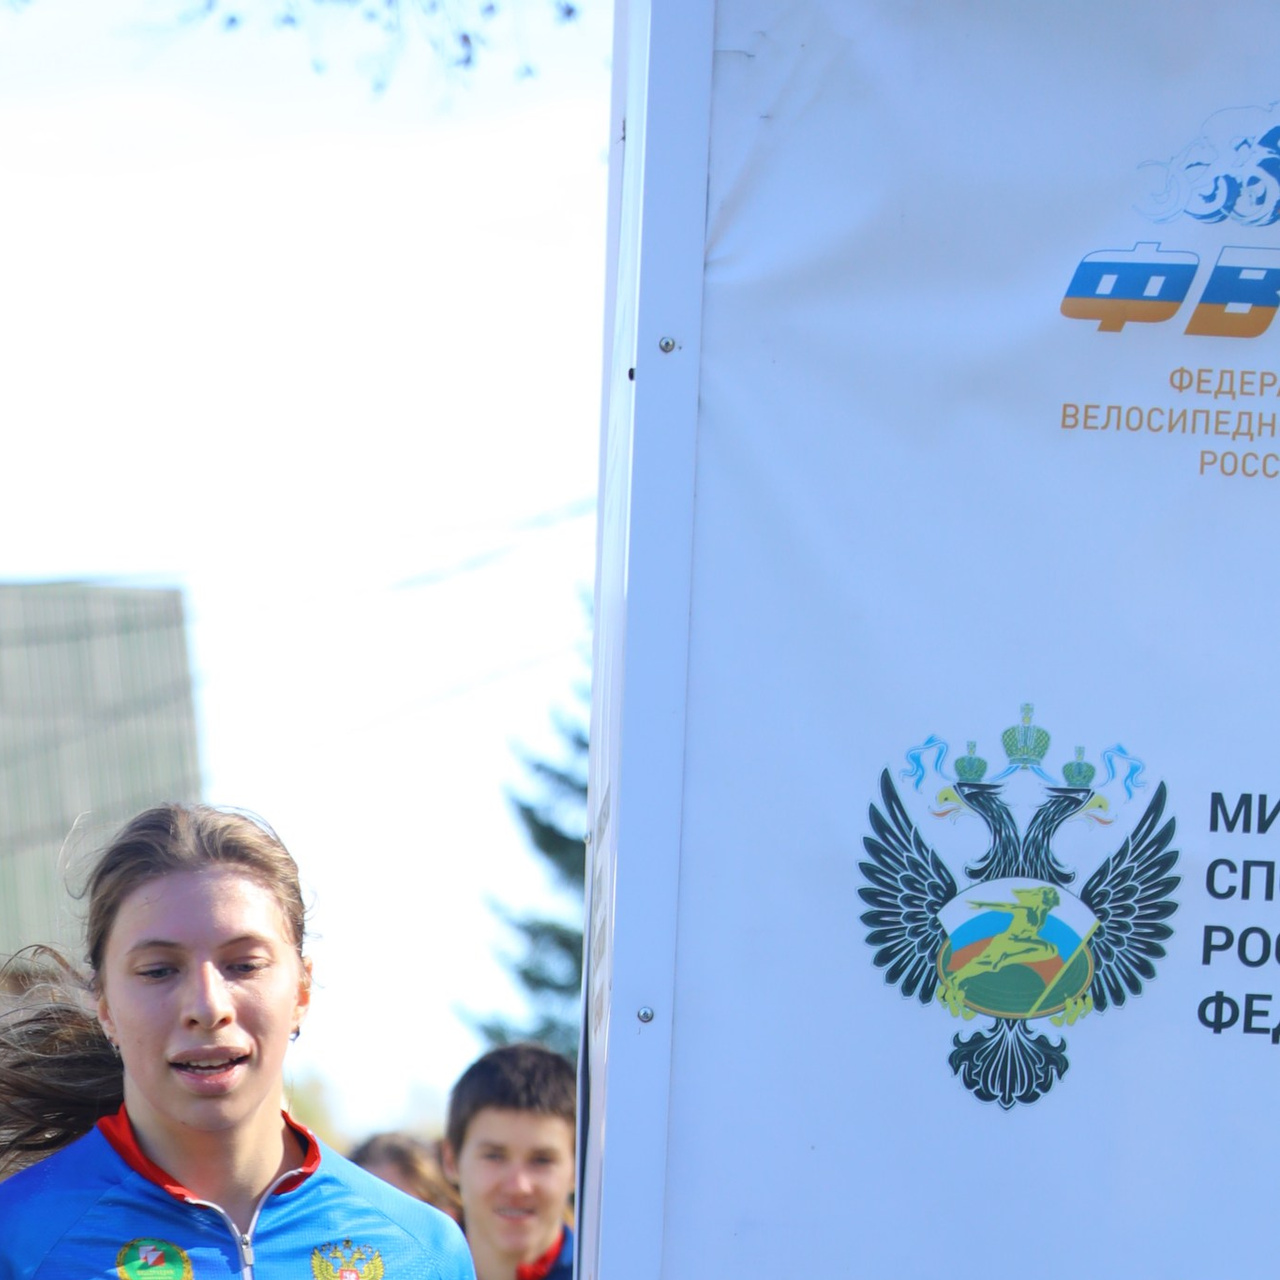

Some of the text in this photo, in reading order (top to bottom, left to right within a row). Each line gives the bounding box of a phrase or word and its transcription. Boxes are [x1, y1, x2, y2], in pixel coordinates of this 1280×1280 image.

[1169, 366, 1280, 401] ФЕДЕР
[1060, 404, 1280, 442] ВЕЛОСИПЕДН
[1199, 450, 1280, 479] РОСС
[1205, 858, 1280, 901] СП
[1202, 925, 1280, 968] РО
[1197, 990, 1280, 1045] ФЕ
